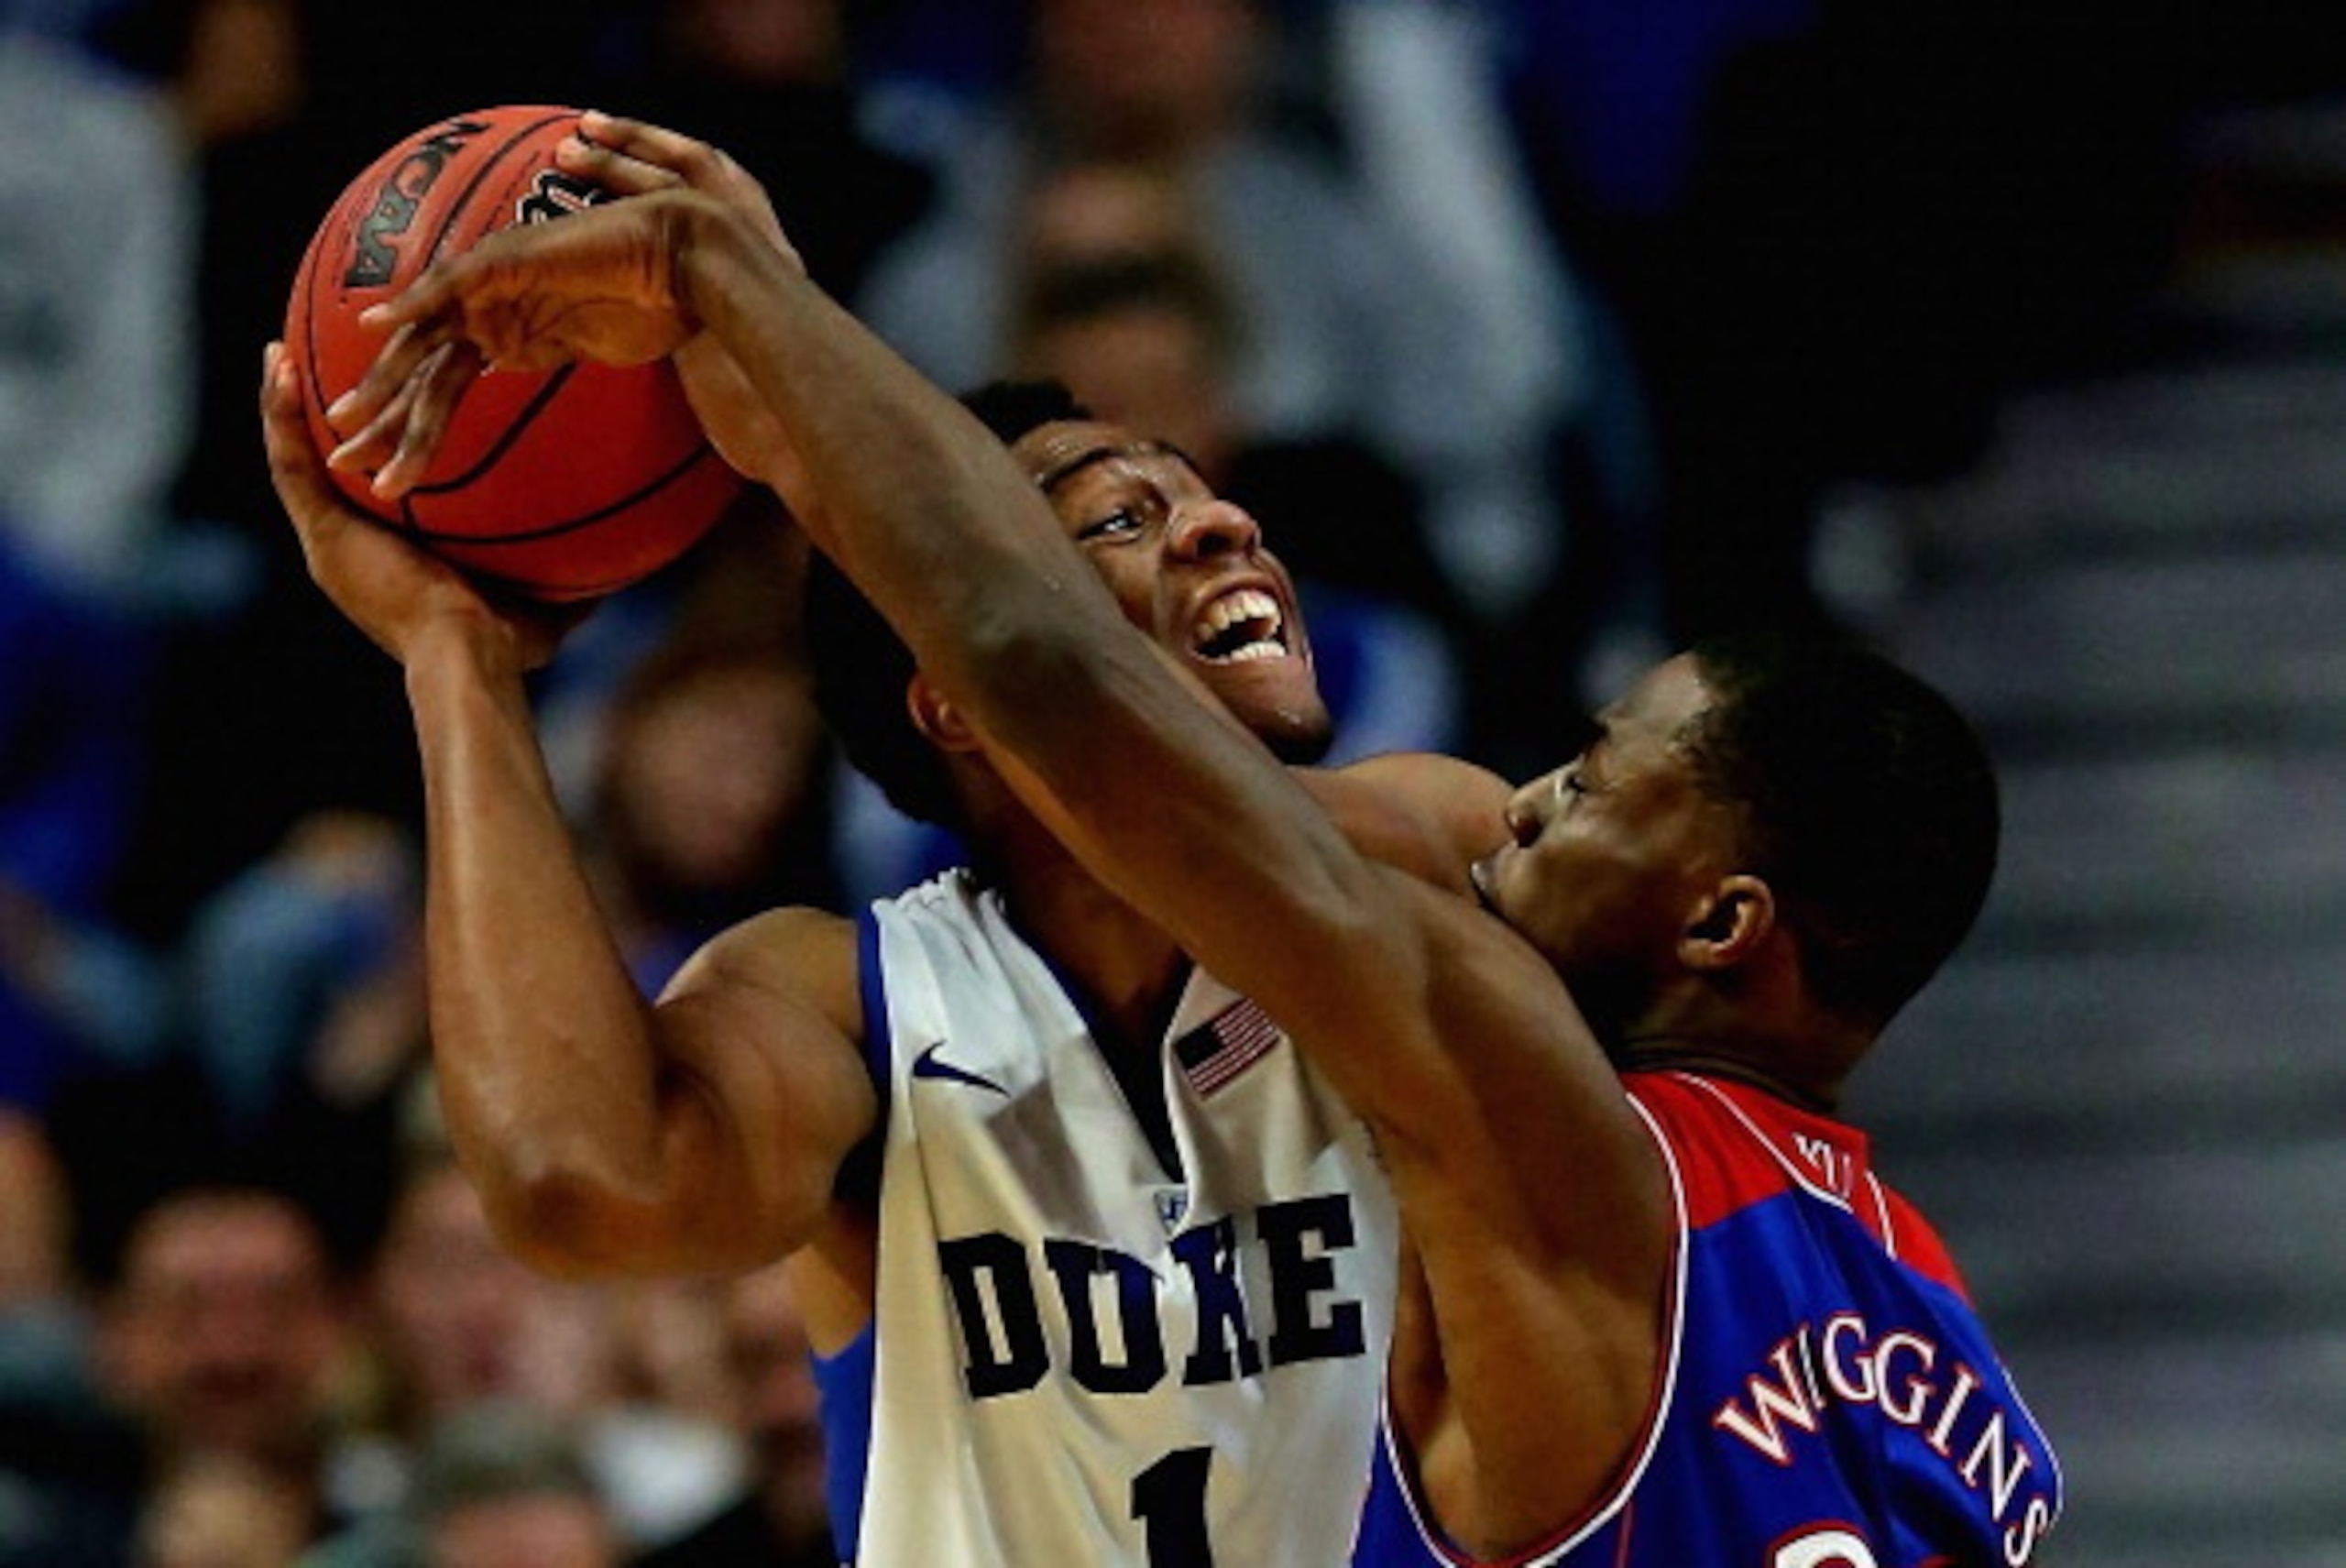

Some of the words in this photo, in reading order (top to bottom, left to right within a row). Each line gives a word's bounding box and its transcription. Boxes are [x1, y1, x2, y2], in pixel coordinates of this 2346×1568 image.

[344, 118, 493, 288] NCAA
[937, 1193, 1366, 1400] DUKE
[1130, 1446, 1213, 1568] 1
[1712, 1310, 2050, 1568] WIGGINS
